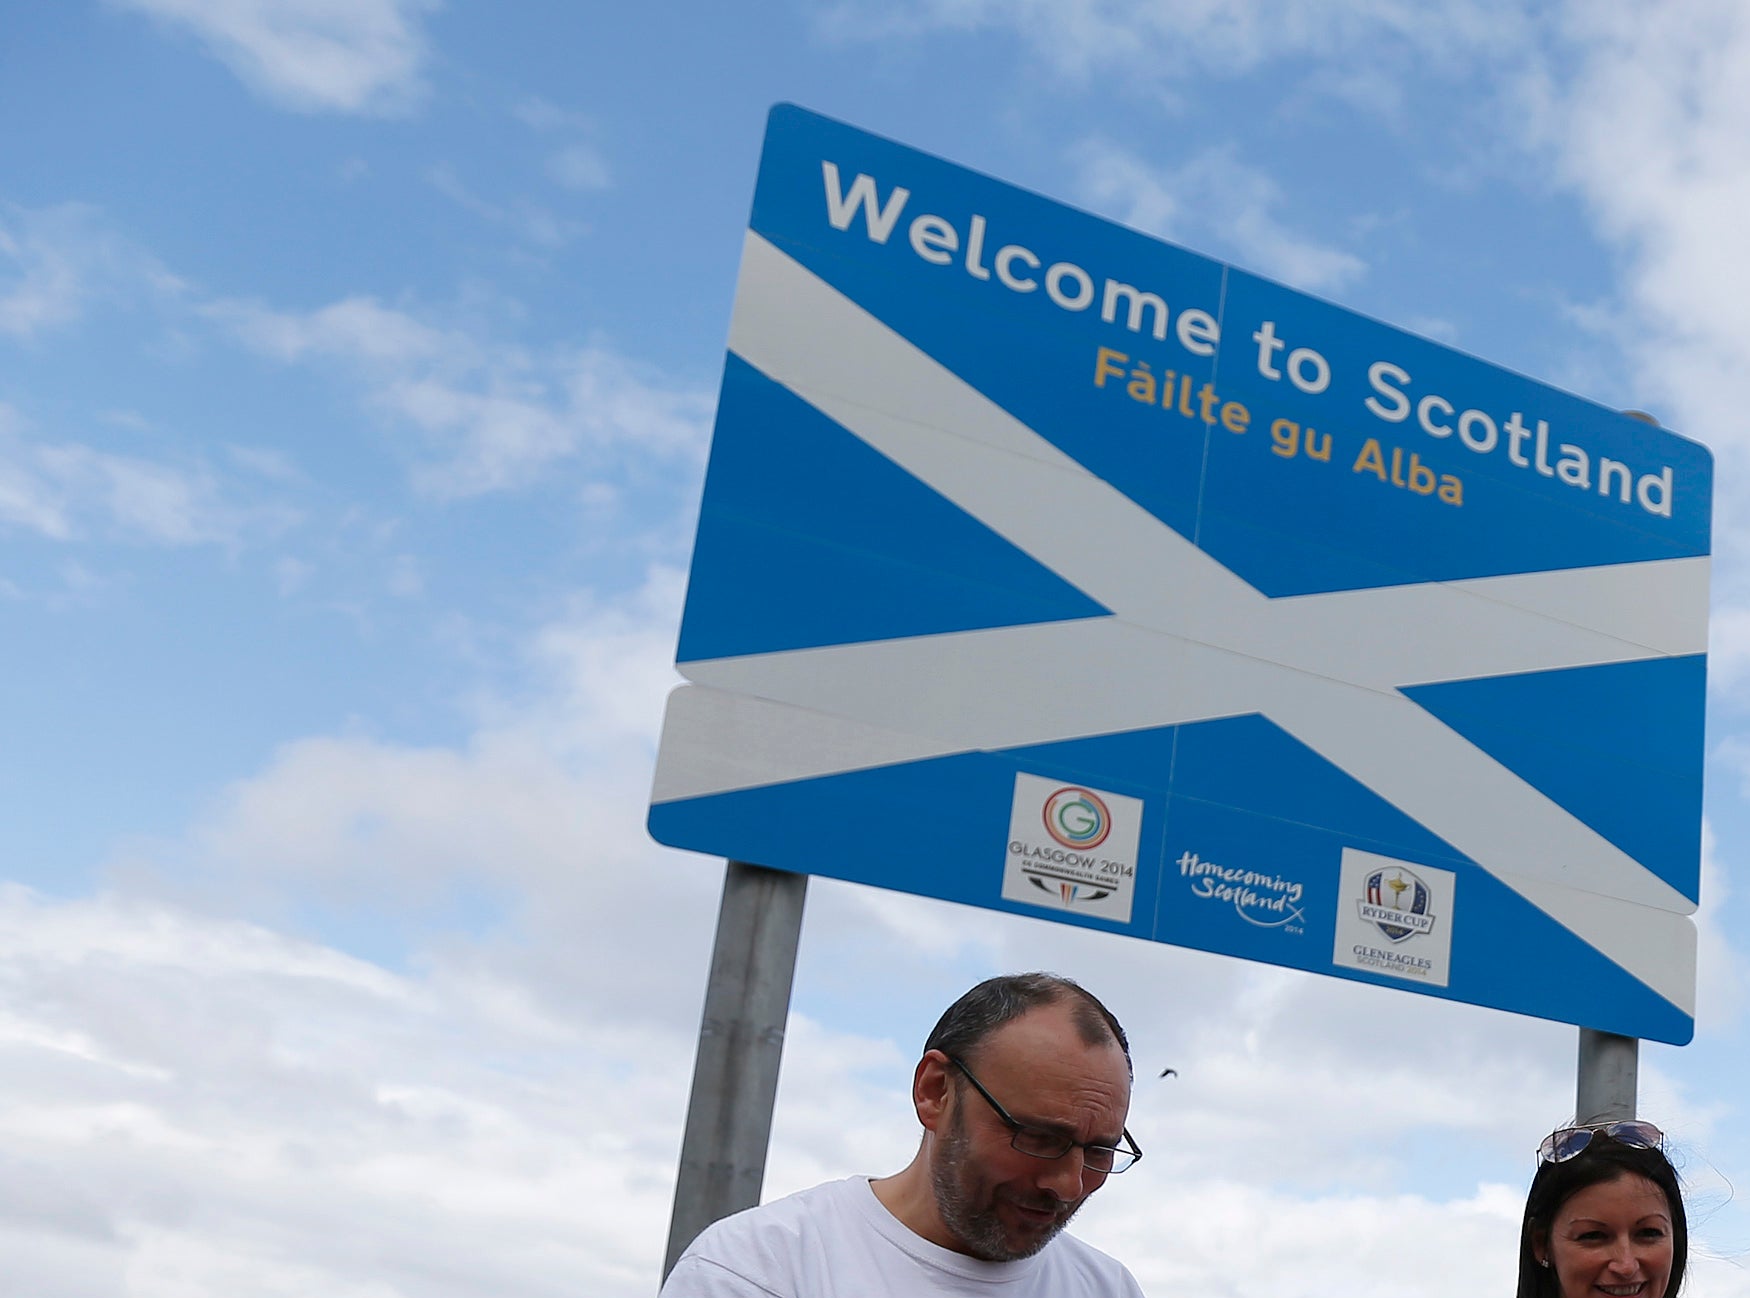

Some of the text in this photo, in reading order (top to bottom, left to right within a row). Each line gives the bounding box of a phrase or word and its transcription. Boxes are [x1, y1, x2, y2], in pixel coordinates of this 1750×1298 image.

[823, 161, 1672, 517] Welcome to Scotland
[1095, 348, 1462, 505] Fàilte gu Alba
[1009, 841, 1134, 877] GLASGOW 2014
[1176, 850, 1303, 902] Homecoming
[1191, 877, 1288, 913] Scotland
[1362, 906, 1429, 928] RYDER CUP
[1353, 944, 1432, 969] GLENEAGLES
